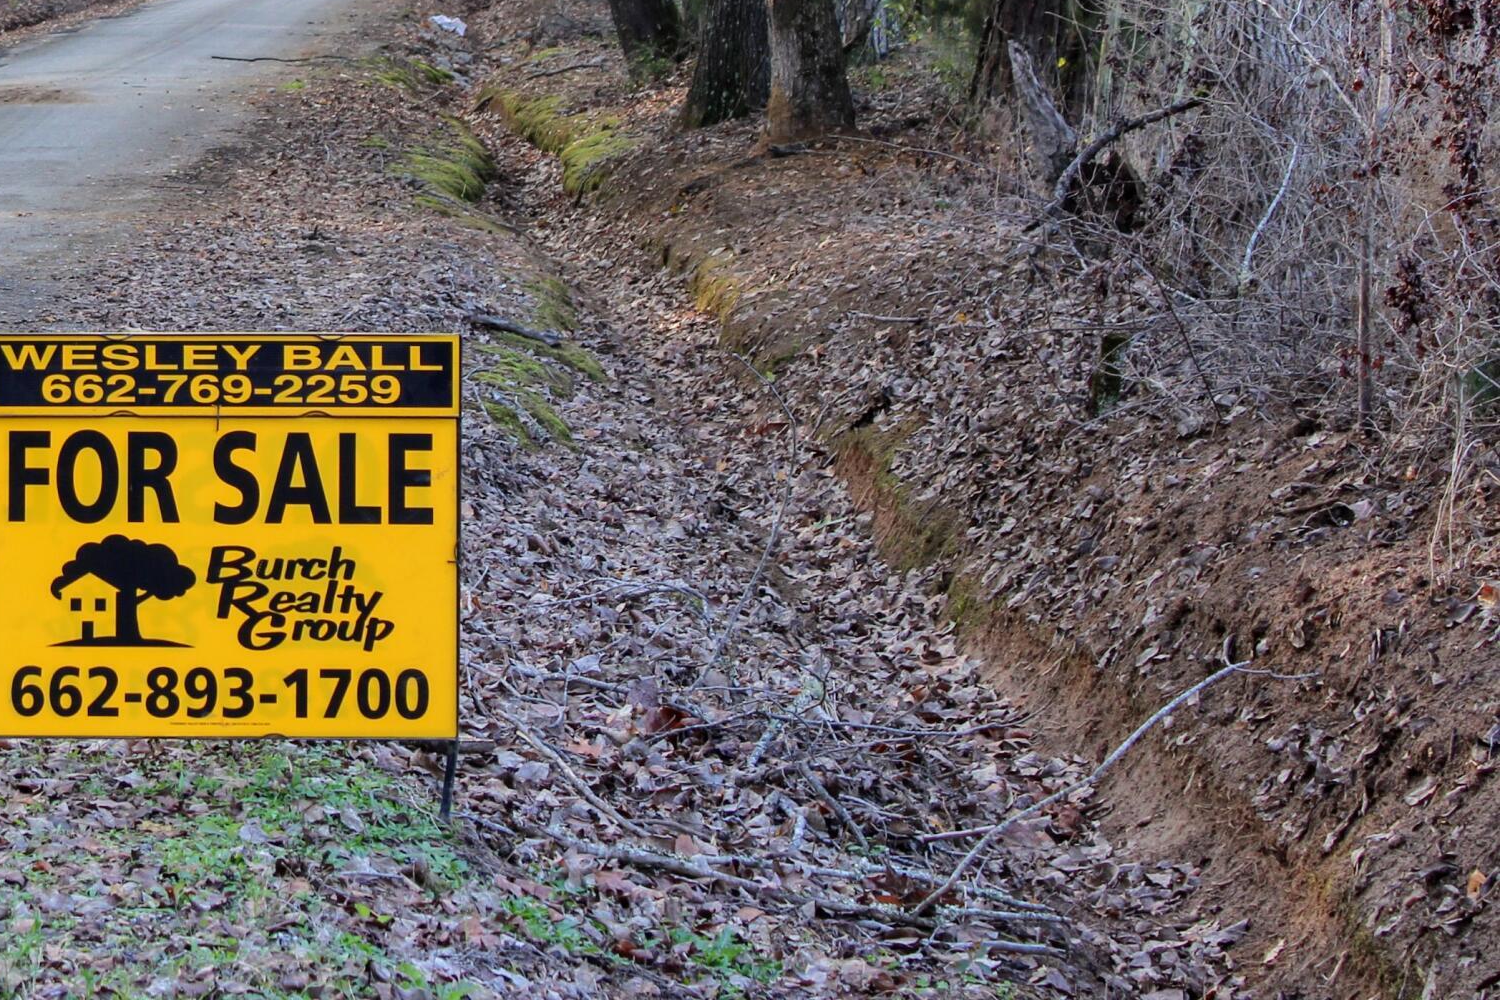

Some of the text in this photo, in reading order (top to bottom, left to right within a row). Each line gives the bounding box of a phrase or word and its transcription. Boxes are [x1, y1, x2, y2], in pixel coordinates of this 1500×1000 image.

[0, 344, 444, 372] WESLEY BALL
[41, 374, 402, 404] 662-769-2259
[8, 429, 434, 525] FOR SALE
[206, 545, 356, 584] Burch
[216, 580, 384, 620] Realty
[236, 611, 395, 652] Group
[10, 665, 429, 720] 662-893-1700
